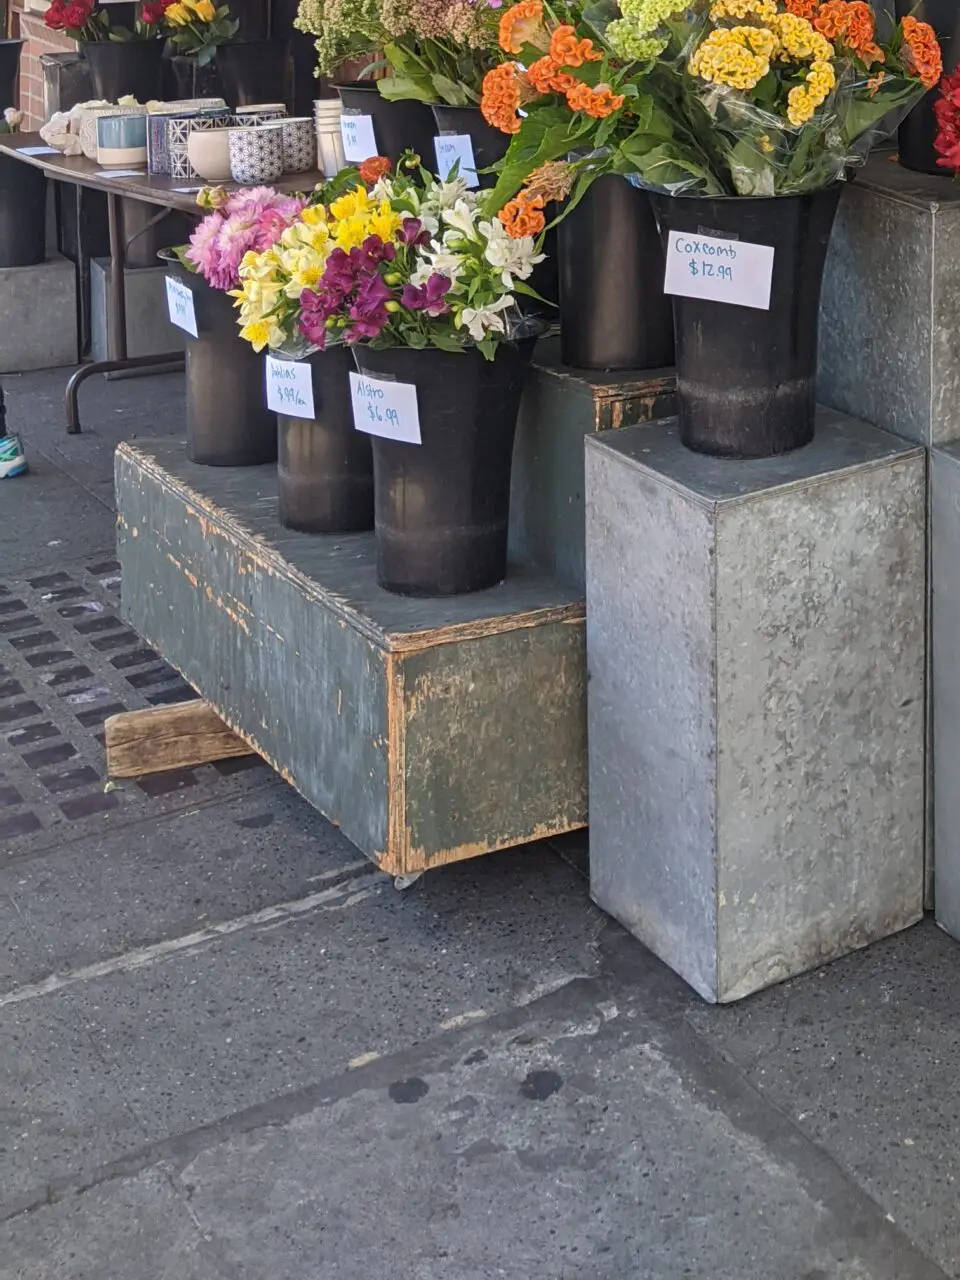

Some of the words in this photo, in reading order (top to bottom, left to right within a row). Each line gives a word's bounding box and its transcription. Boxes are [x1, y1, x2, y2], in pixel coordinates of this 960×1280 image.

[689, 258, 733, 281] $12.99
[357, 380, 384, 400] Alstro
[367, 401, 400, 429] $6.99
